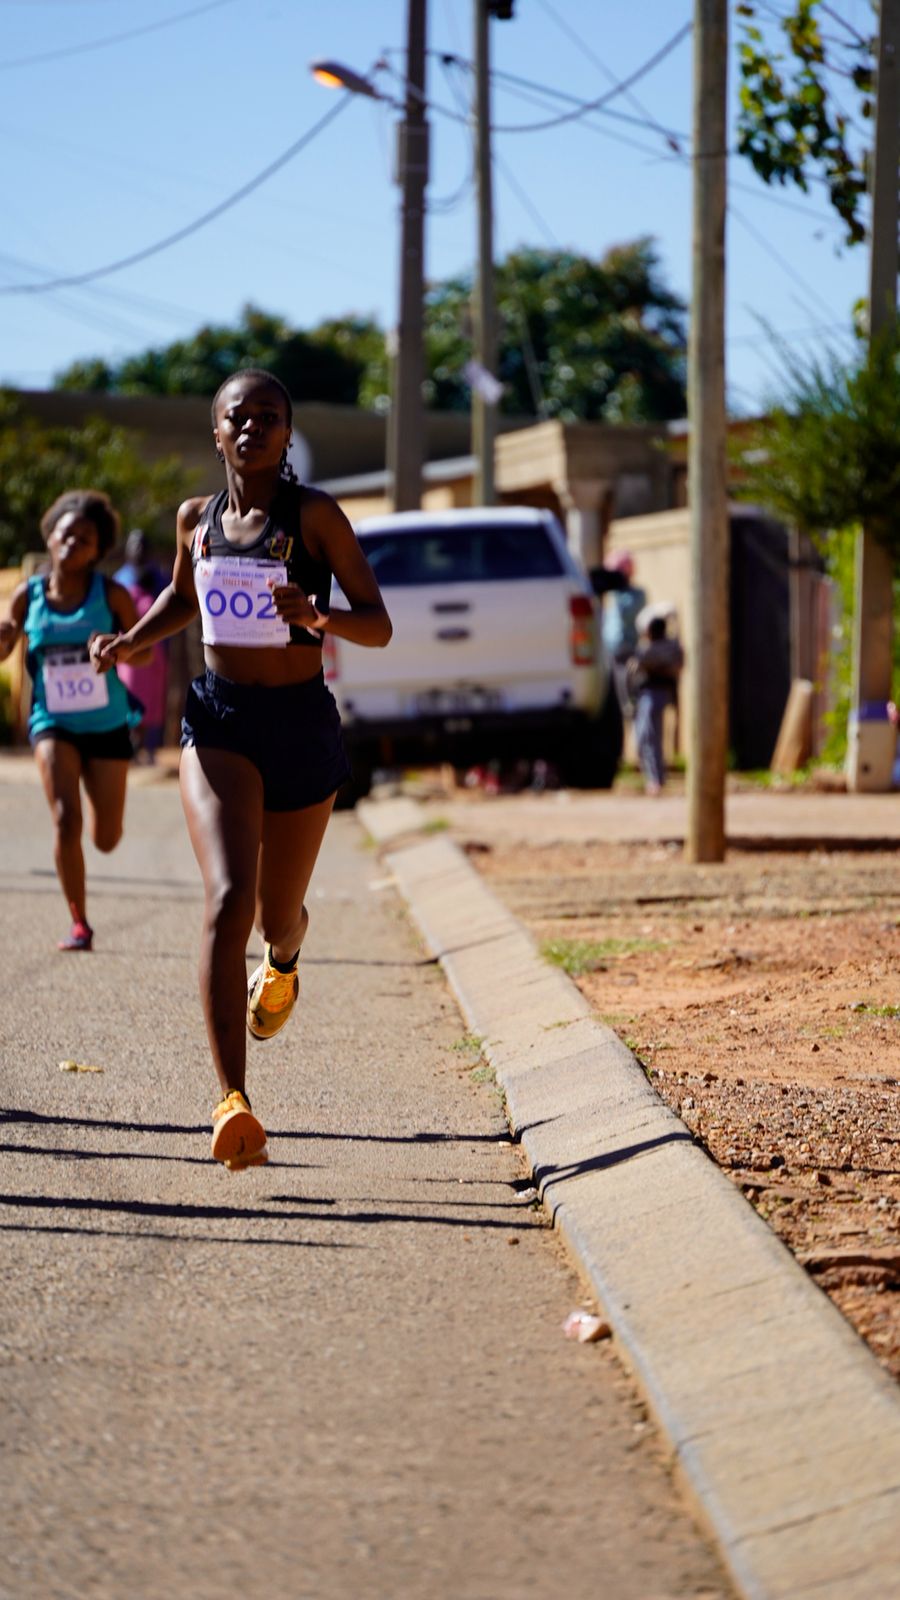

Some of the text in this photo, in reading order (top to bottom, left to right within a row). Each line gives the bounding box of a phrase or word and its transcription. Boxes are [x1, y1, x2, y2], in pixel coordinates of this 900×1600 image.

[222, 578, 253, 588] STREET MILE
[205, 589, 276, 619] 002
[56, 677, 94, 700] 130
